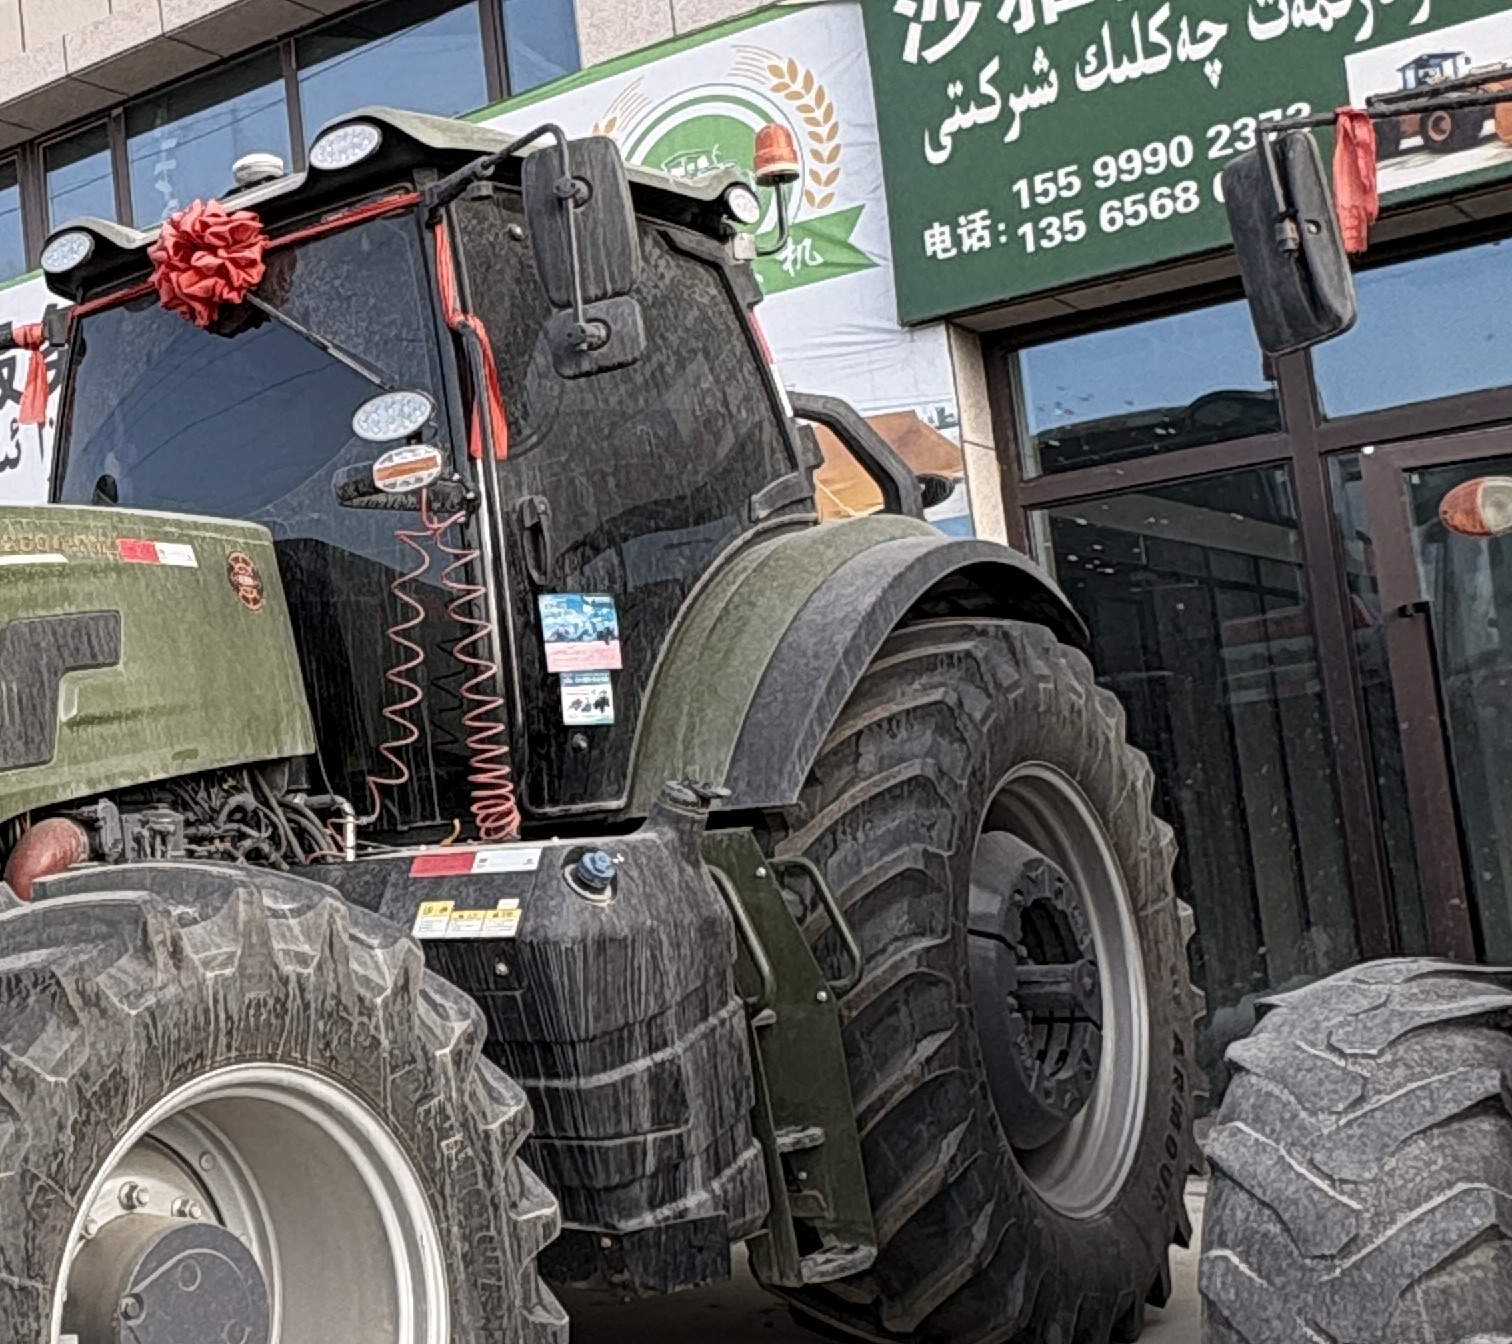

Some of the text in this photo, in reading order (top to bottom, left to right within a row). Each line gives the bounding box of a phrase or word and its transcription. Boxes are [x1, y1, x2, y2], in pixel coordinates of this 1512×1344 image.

[1012, 165, 1082, 210] 155
[1092, 135, 1194, 189] 9990
[1017, 209, 1087, 254] 135
[1099, 180, 1200, 233] 6568
